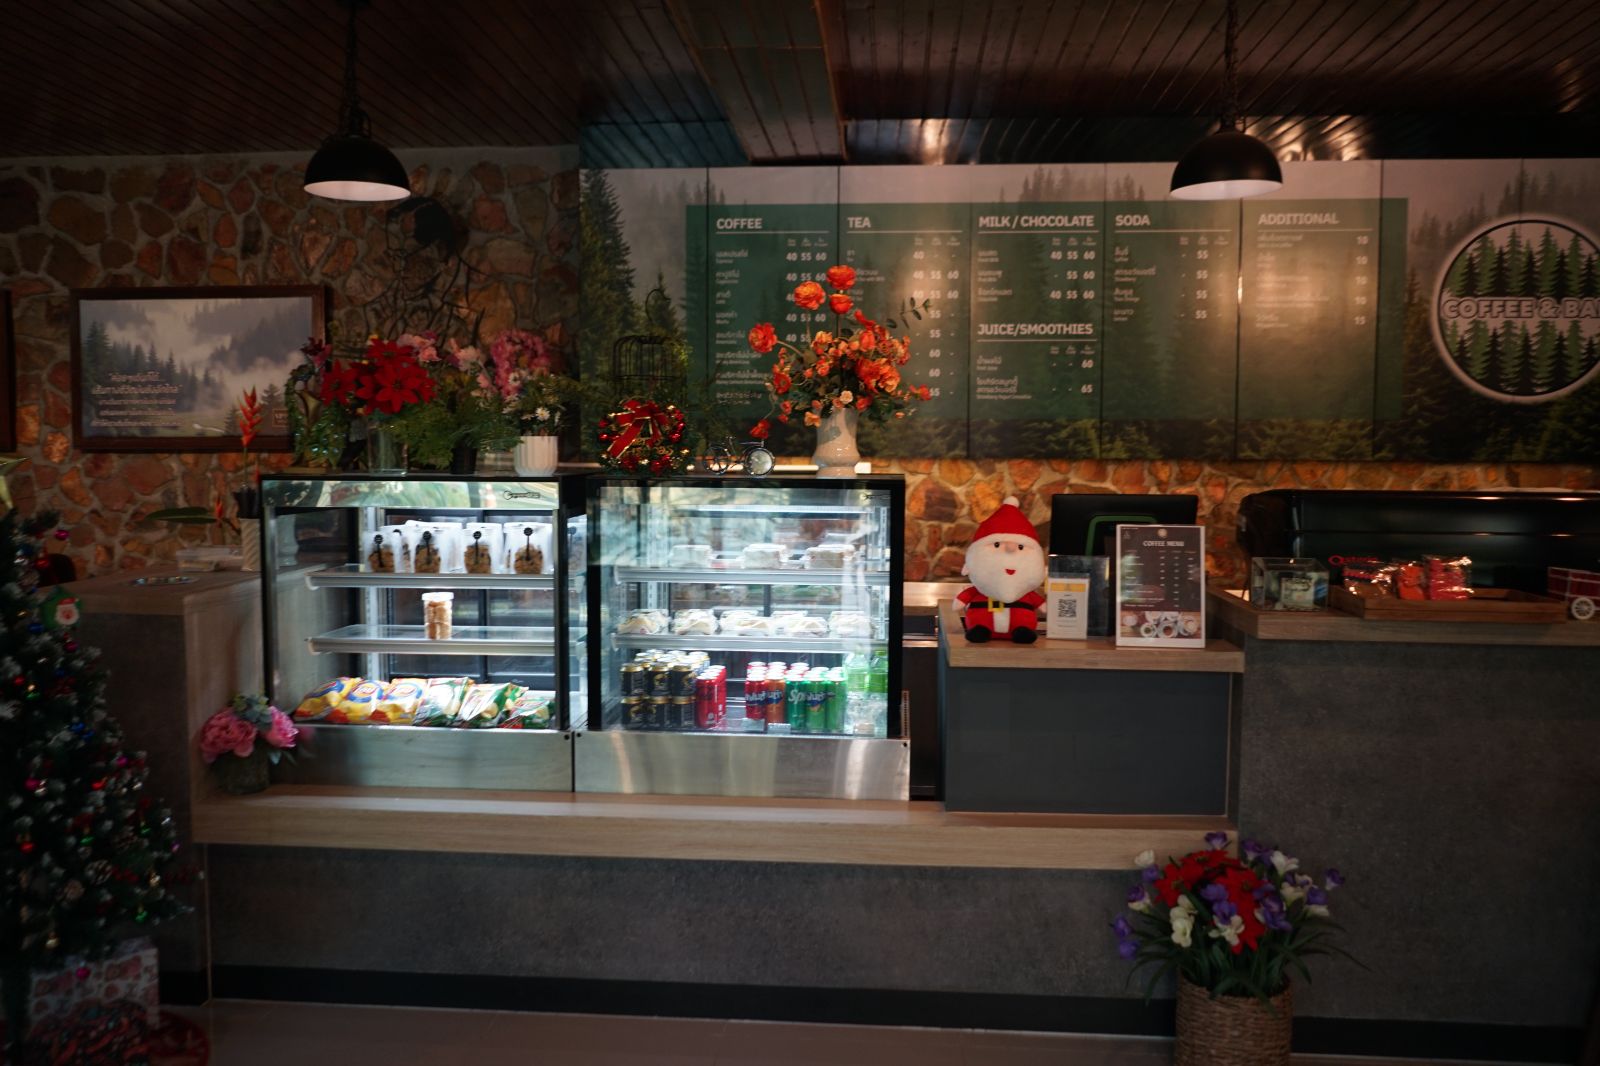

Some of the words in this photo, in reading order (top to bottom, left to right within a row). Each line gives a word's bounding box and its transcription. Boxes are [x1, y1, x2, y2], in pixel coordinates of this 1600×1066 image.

[716, 218, 762, 229] COFFEE
[848, 217, 871, 228] TEA
[979, 216, 1010, 227] MILK
[1021, 215, 1095, 227] CHOCOLATE
[1115, 215, 1150, 226] SODA
[1258, 213, 1340, 225] ADDITIONAL
[786, 252, 798, 261] 40
[801, 252, 812, 261] 55
[816, 252, 827, 261] 60
[1066, 251, 1078, 260] 55
[1083, 251, 1095, 260] 60
[786, 273, 797, 281] 40
[800, 273, 812, 281] 55
[1083, 271, 1095, 280] 60
[1050, 290, 1062, 299] 40
[1066, 290, 1078, 299] 55
[1083, 290, 1095, 299] 60
[1443, 299, 1534, 319] COFFEE
[1539, 299, 1561, 319] &
[786, 313, 797, 322] 40
[815, 313, 826, 322] 60
[977, 324, 1093, 336] JUICE/SMOOTHIES
[786, 334, 797, 342] 40
[929, 349, 941, 358] 60
[929, 368, 940, 377] 60
